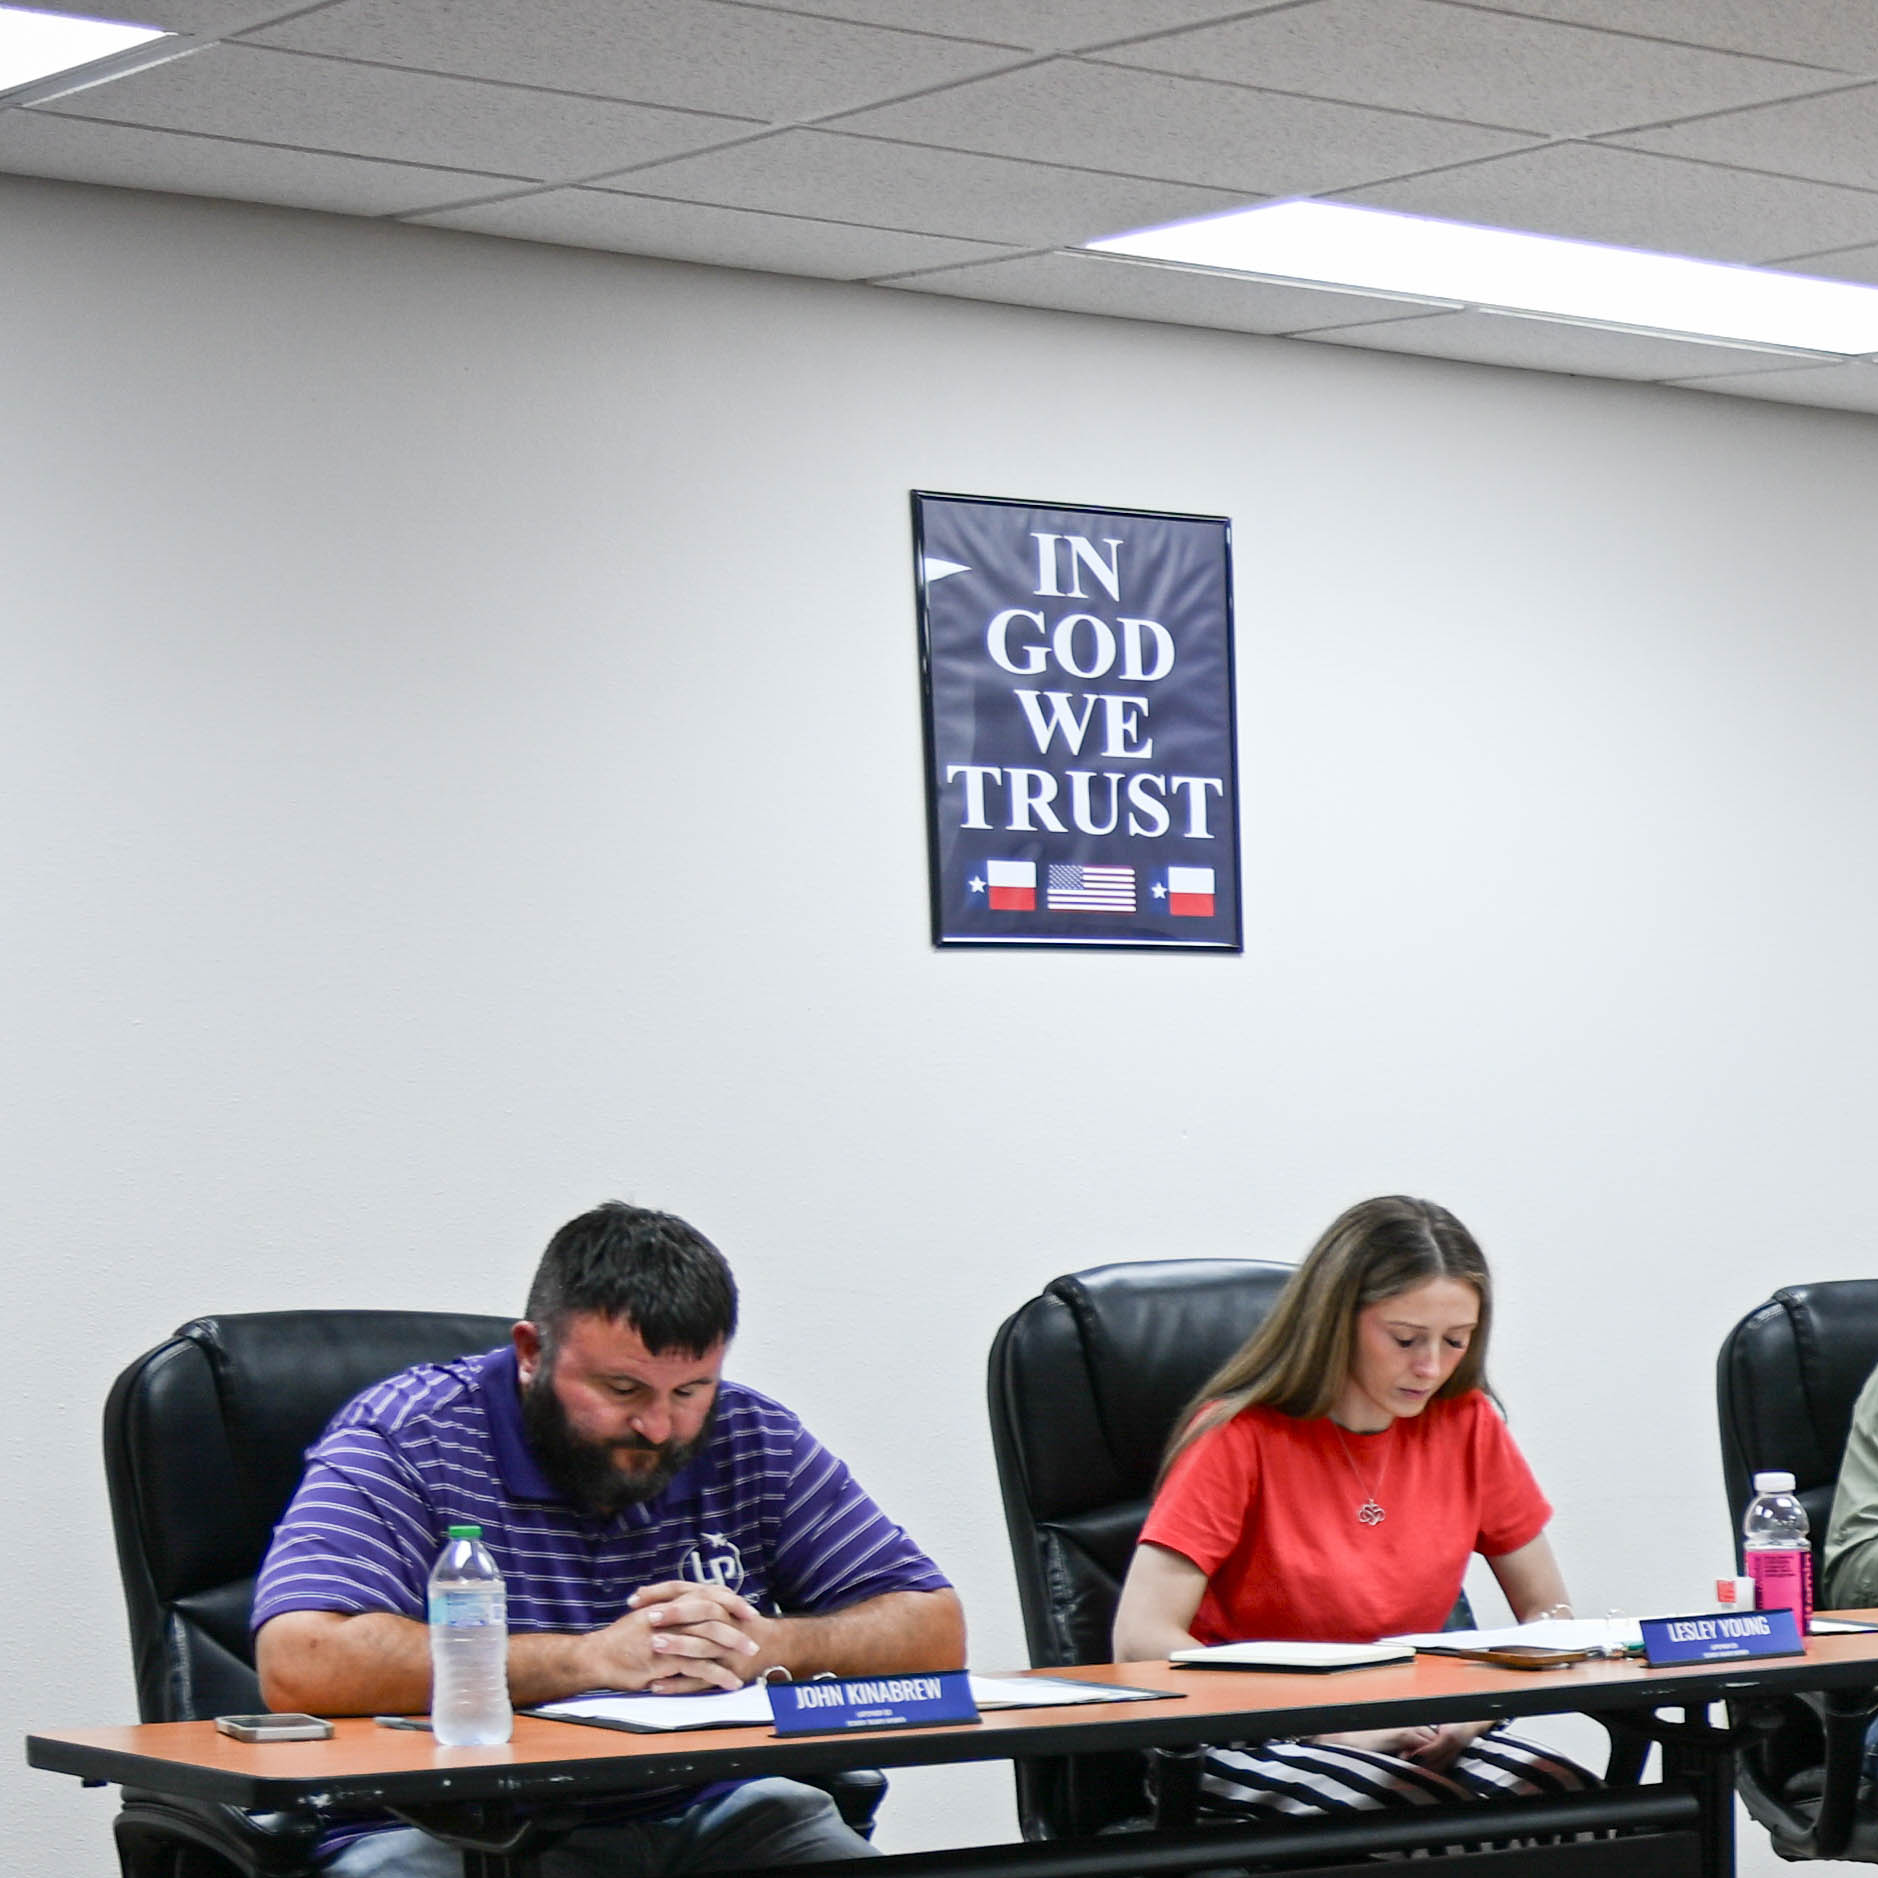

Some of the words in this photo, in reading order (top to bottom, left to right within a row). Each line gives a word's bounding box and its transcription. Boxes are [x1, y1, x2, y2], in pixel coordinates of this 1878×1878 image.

[1030, 532, 1124, 602] IN
[986, 609, 1176, 682] GOD
[1014, 688, 1153, 760] WE
[946, 765, 1224, 839] TRUST
[1666, 1620, 1717, 1642] LESLEY
[1718, 1616, 1771, 1638] YOUNG
[795, 1684, 845, 1709] JOHN
[845, 1677, 942, 1705] KINABREW
